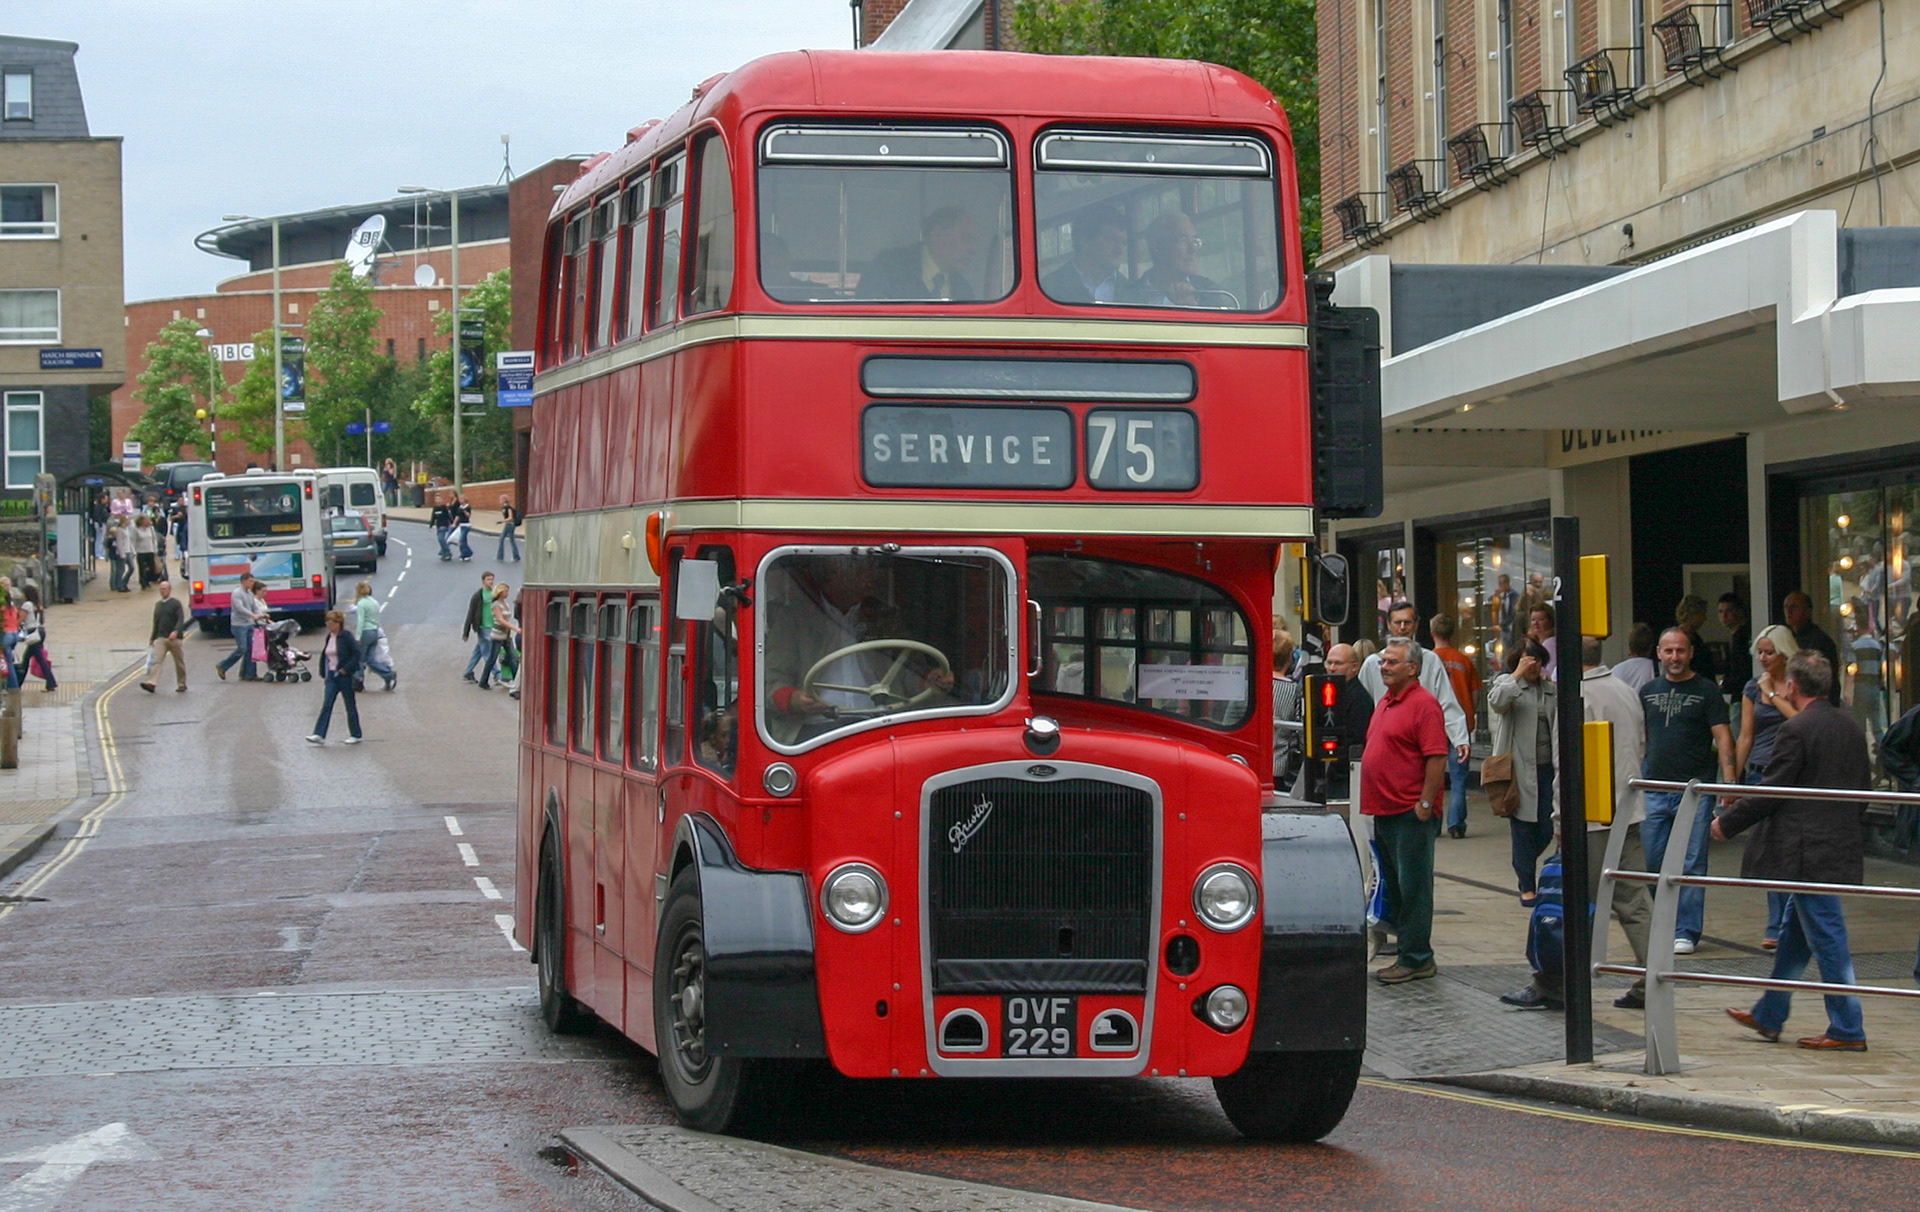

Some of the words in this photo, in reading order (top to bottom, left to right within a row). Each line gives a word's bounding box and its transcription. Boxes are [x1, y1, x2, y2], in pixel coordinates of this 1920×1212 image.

[210, 345, 252, 360] BBC
[873, 433, 1051, 465] SERVICE
[1088, 416, 1155, 483] 75
[217, 523, 230, 536] 21
[948, 793, 993, 853] Bristol
[1008, 997, 1070, 1025] OVF
[1008, 1027, 1070, 1055] 229
